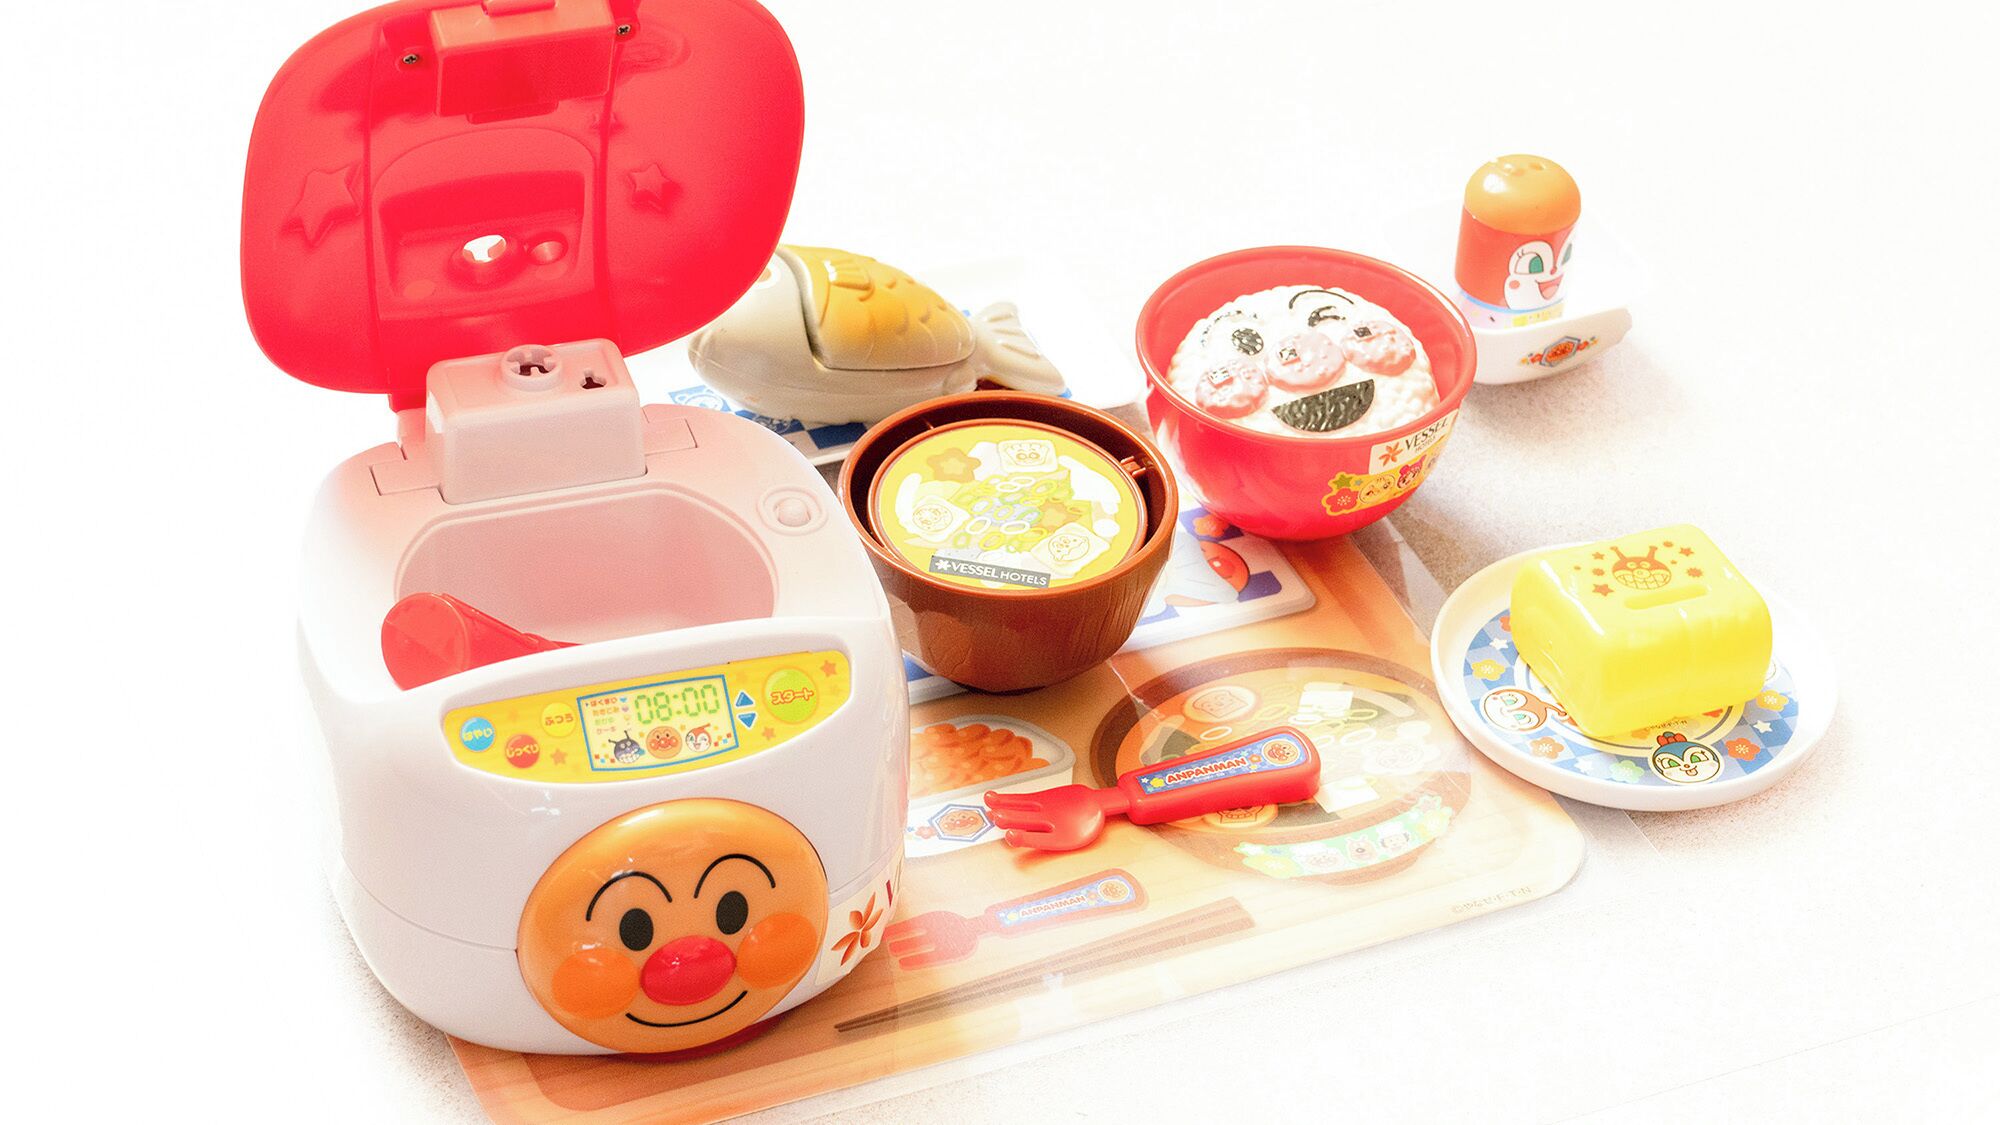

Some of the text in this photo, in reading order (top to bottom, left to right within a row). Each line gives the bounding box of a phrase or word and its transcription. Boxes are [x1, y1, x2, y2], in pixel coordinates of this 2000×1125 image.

[1405, 417, 1448, 450] VESSEL
[950, 561, 1048, 587] VESSEL HOTELS
[634, 683, 721, 725] 08:00
[770, 687, 814, 705] スタート
[544, 712, 574, 727] ふつう
[462, 727, 494, 742] はやい
[1166, 757, 1247, 785] ANPANMAN
[1019, 894, 1086, 918] ANPANMAN
